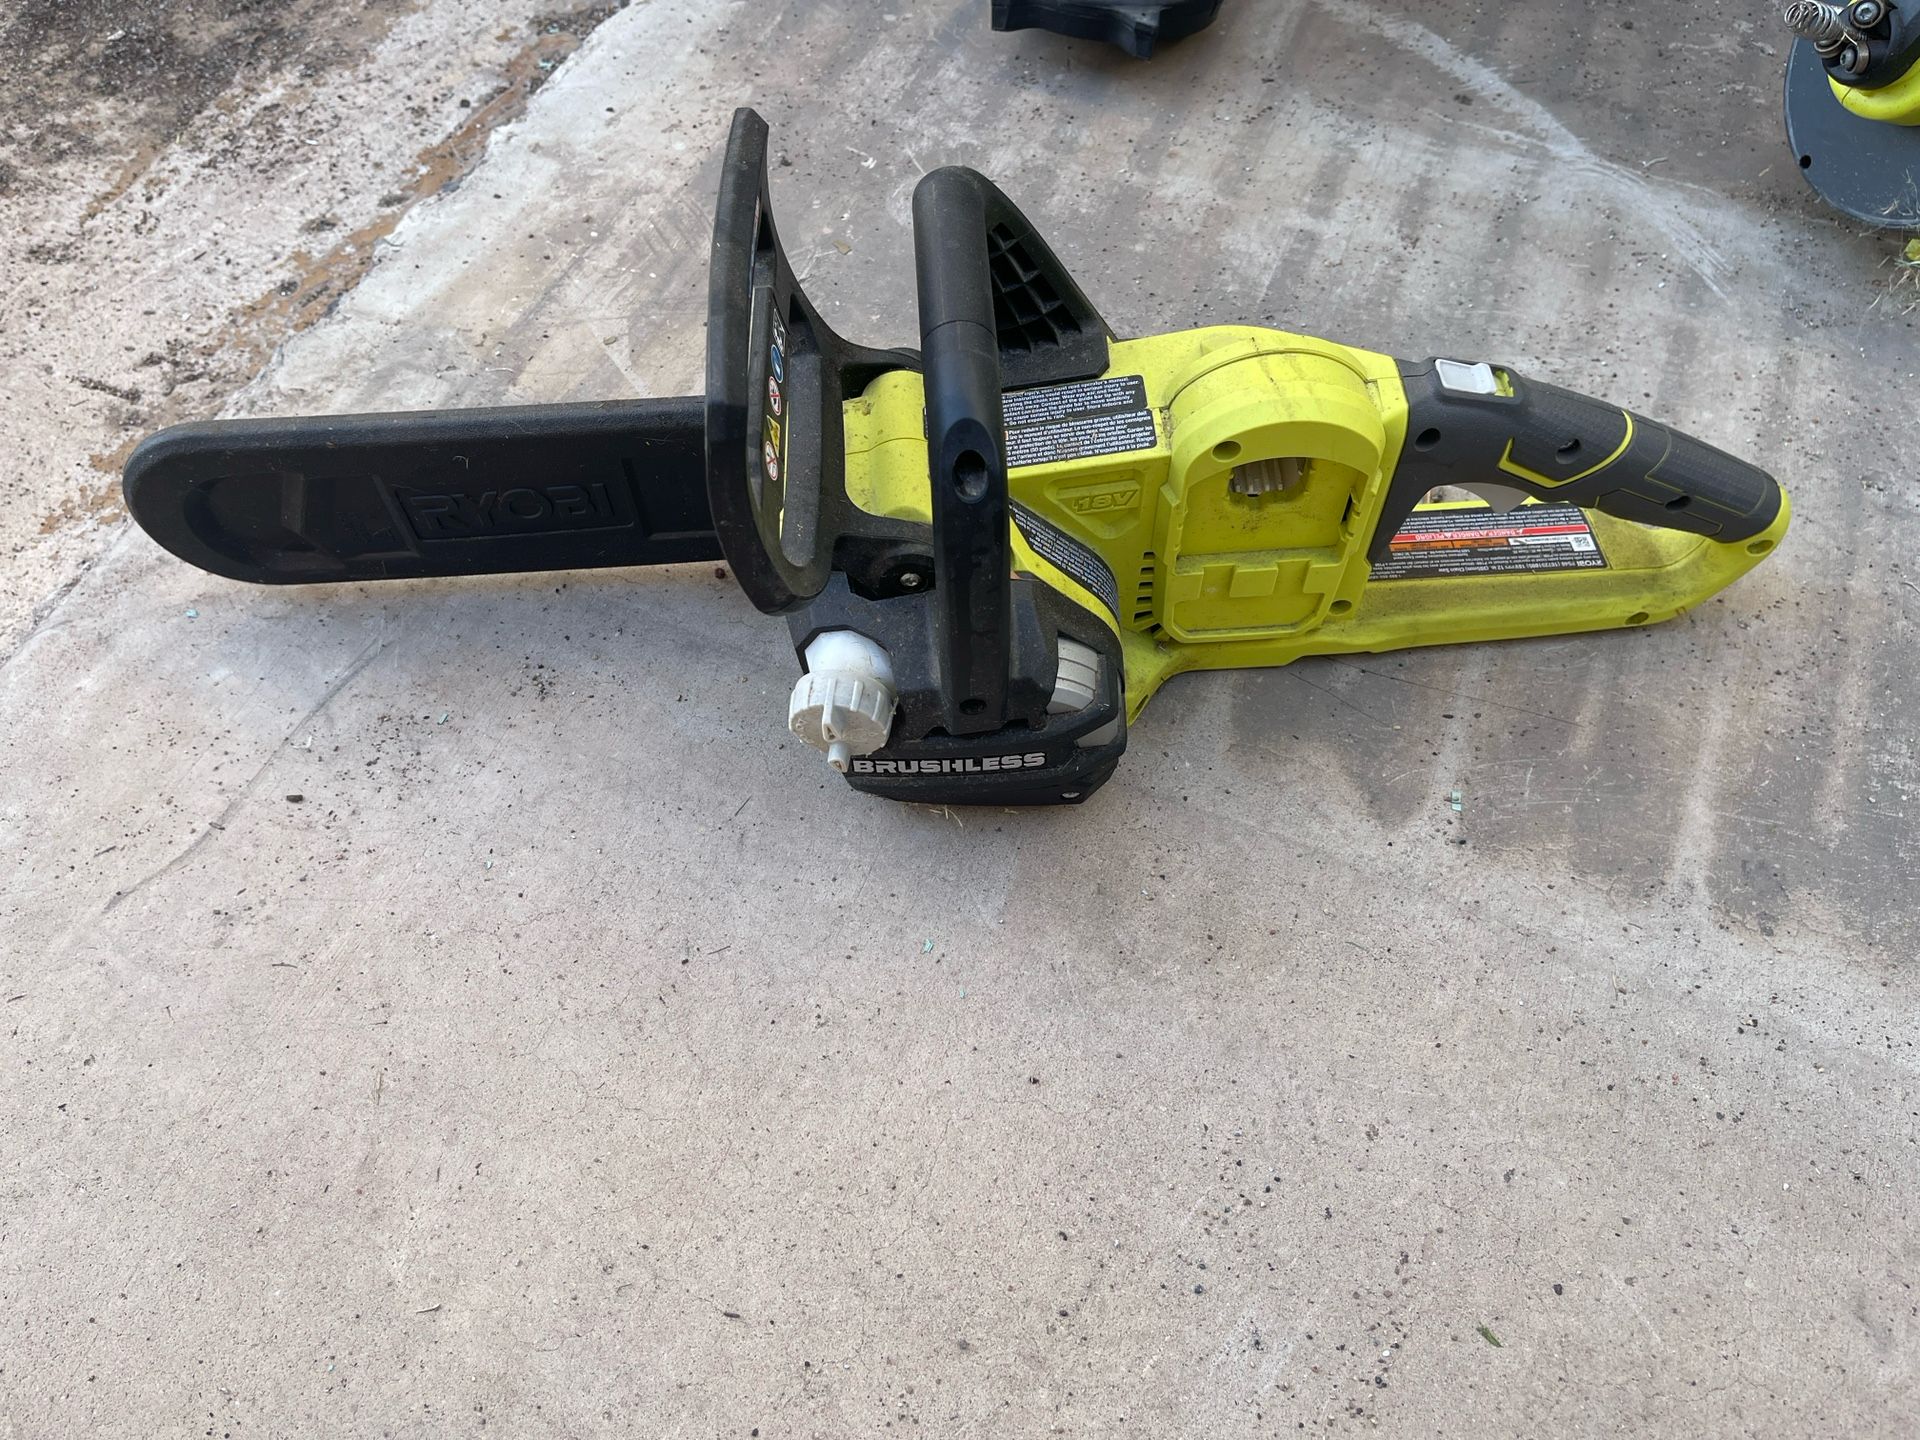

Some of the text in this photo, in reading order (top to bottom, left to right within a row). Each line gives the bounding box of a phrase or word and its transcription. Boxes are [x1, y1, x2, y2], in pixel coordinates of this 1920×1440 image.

[410, 484, 615, 530] RYOBI
[1076, 489, 1137, 512] 18V
[852, 752, 1046, 773] BRUSHLESS
